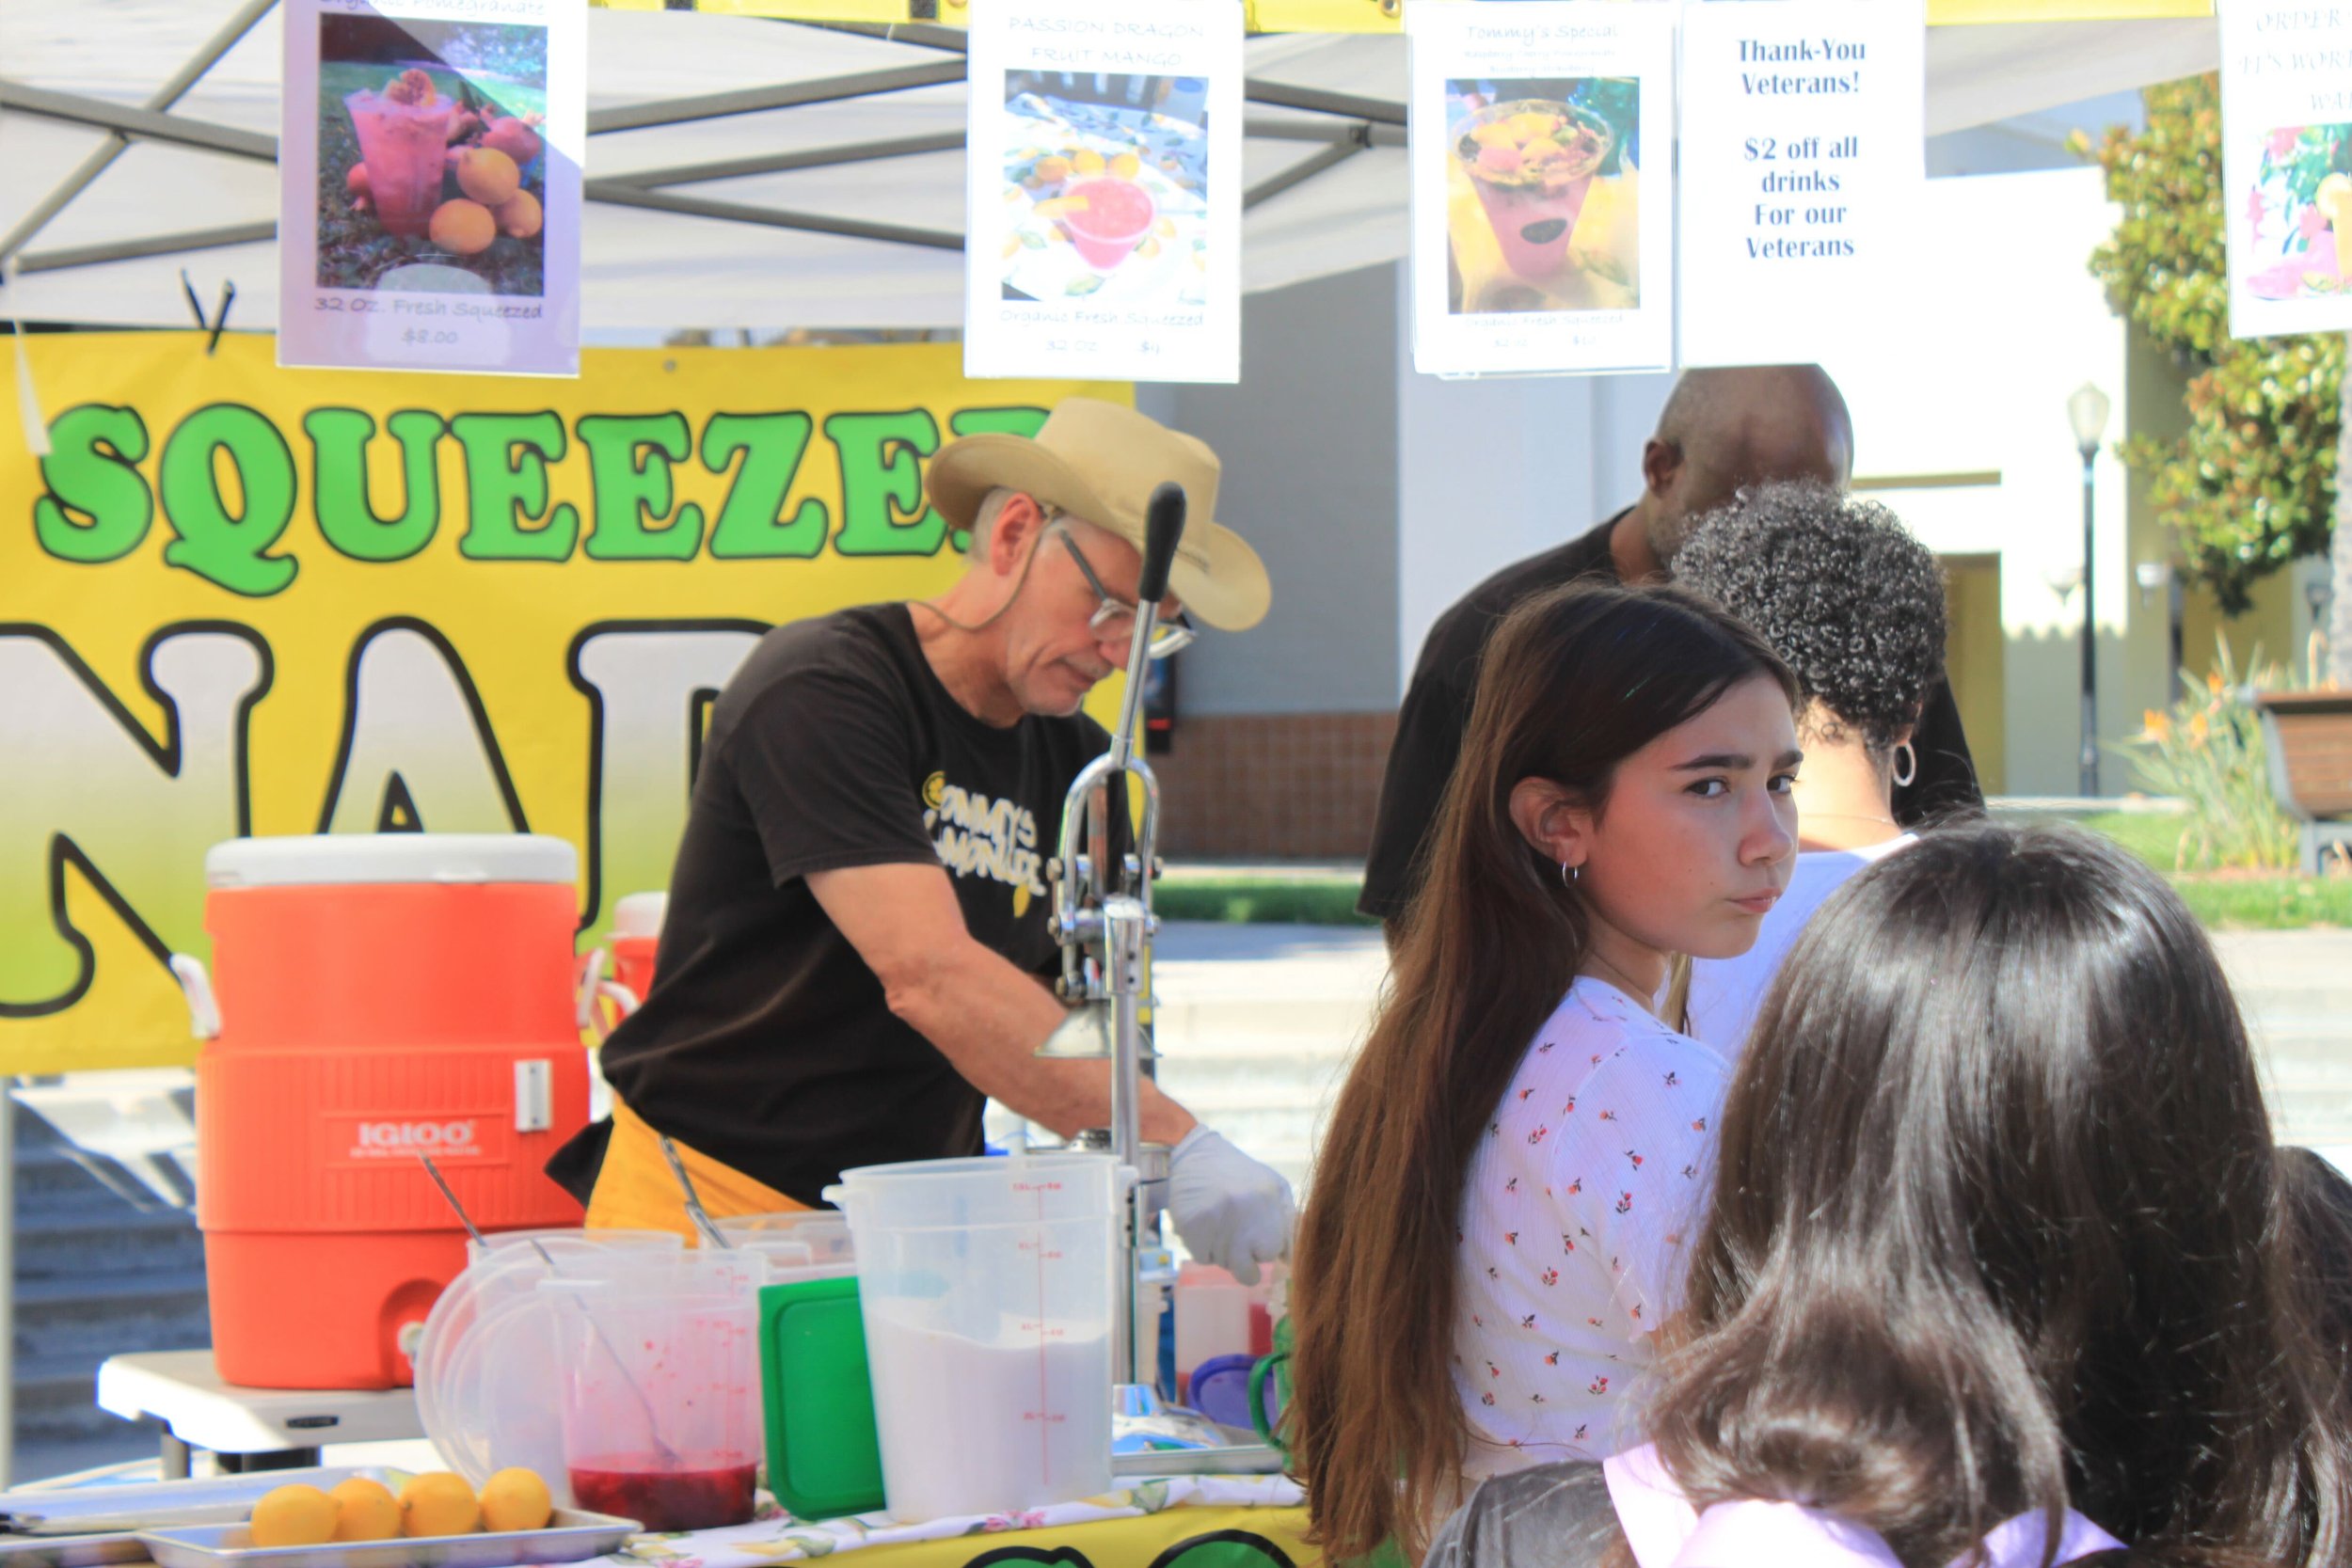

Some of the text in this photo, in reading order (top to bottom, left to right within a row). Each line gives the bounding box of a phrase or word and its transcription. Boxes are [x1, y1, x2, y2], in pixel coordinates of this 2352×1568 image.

[1009, 17, 1204, 38] PASSION DRAGON
[1466, 24, 1618, 47] Tommy's Special
[1031, 47, 1182, 67] FRUIT MANGO
[1737, 38, 1866, 62] Thank-You
[1741, 71, 1860, 95] Veterans!
[1743, 135, 1858, 162] $2 off all
[1761, 170, 1840, 194] drinks
[1754, 203, 1847, 226] For our
[1746, 236, 1854, 260] Veterans
[314, 296, 343, 311] 32
[393, 300, 448, 316] Fresh
[453, 303, 543, 323] Squeezed
[1000, 309, 1204, 330] Organic Fresh Squeezed
[402, 328, 459, 346] $8.00
